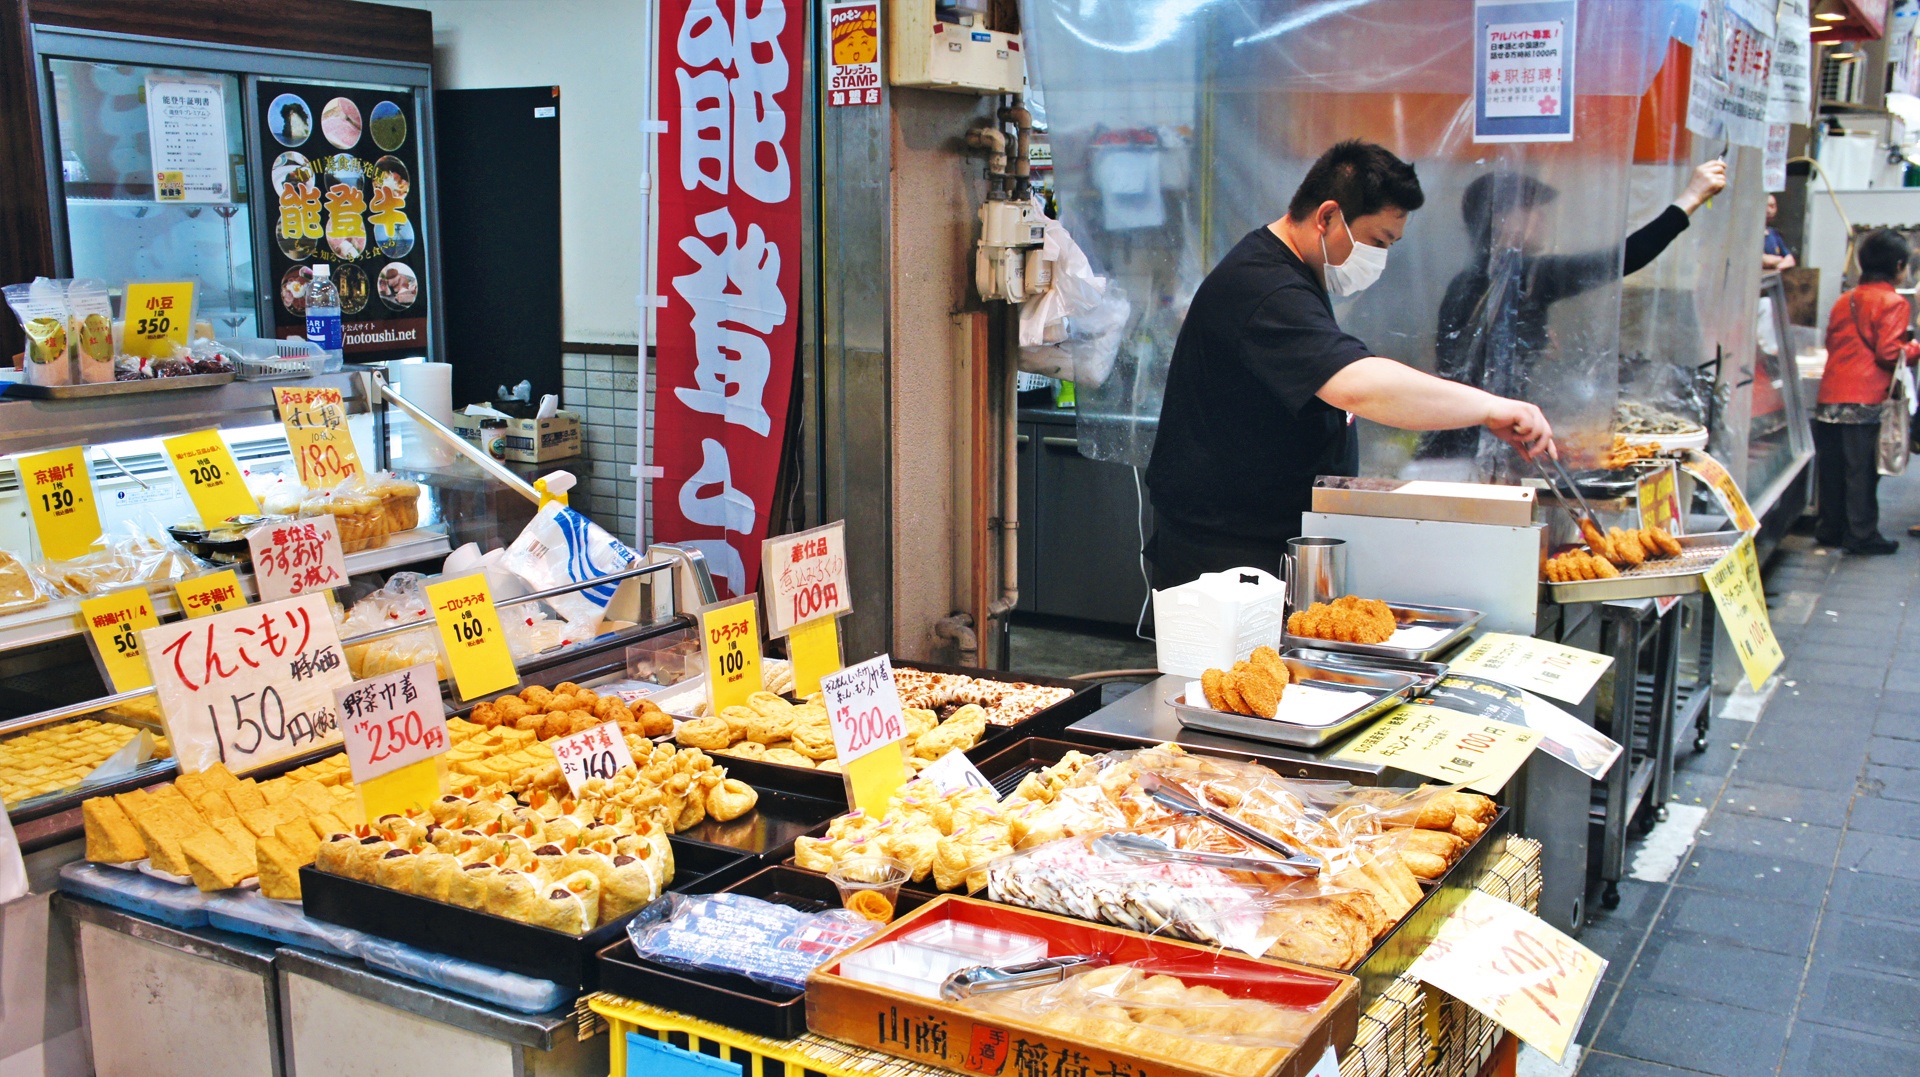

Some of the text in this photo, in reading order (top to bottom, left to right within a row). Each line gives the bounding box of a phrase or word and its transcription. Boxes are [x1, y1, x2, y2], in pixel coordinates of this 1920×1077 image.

[832, 9, 861, 26] クロモン
[1490, 41, 1546, 51] 日本語と中国語が
[832, 73, 878, 89] STAMP
[836, 64, 872, 76] フレッシュ
[162, 95, 210, 106] 能登牛証明書
[832, 88, 878, 106] 加盟店
[278, 182, 409, 240] 能登牛
[145, 296, 174, 310] 小豆
[136, 317, 170, 335] 350
[281, 390, 341, 405] 本日おすすめ
[287, 406, 341, 431] すし揚
[33, 462, 74, 485] 京揚げ
[190, 464, 221, 485] 200
[42, 488, 74, 512] 130
[271, 523, 318, 546] 奉仕品
[259, 529, 332, 577] うすあげ
[791, 536, 828, 563] 奉仕品
[289, 565, 340, 595] 3枚入
[187, 585, 235, 609] ごま揚げ
[439, 592, 485, 612] 一口ひろうす
[793, 582, 839, 625] 100円
[113, 632, 138, 653] 50
[453, 618, 483, 643] 160
[710, 619, 749, 645] ひろうす
[162, 606, 312, 692] てんこもり
[290, 645, 341, 682] 特価
[719, 650, 743, 676] 100
[342, 671, 418, 720] 野菜巾着
[844, 706, 901, 752] 200円
[1410, 713, 1441, 734] コロッケ
[367, 710, 444, 765] 250円
[1456, 725, 1506, 754] 100円
[582, 750, 627, 781] 160
[878, 1005, 948, 1061] 山商
[1011, 1037, 1147, 1077] 稲荷
